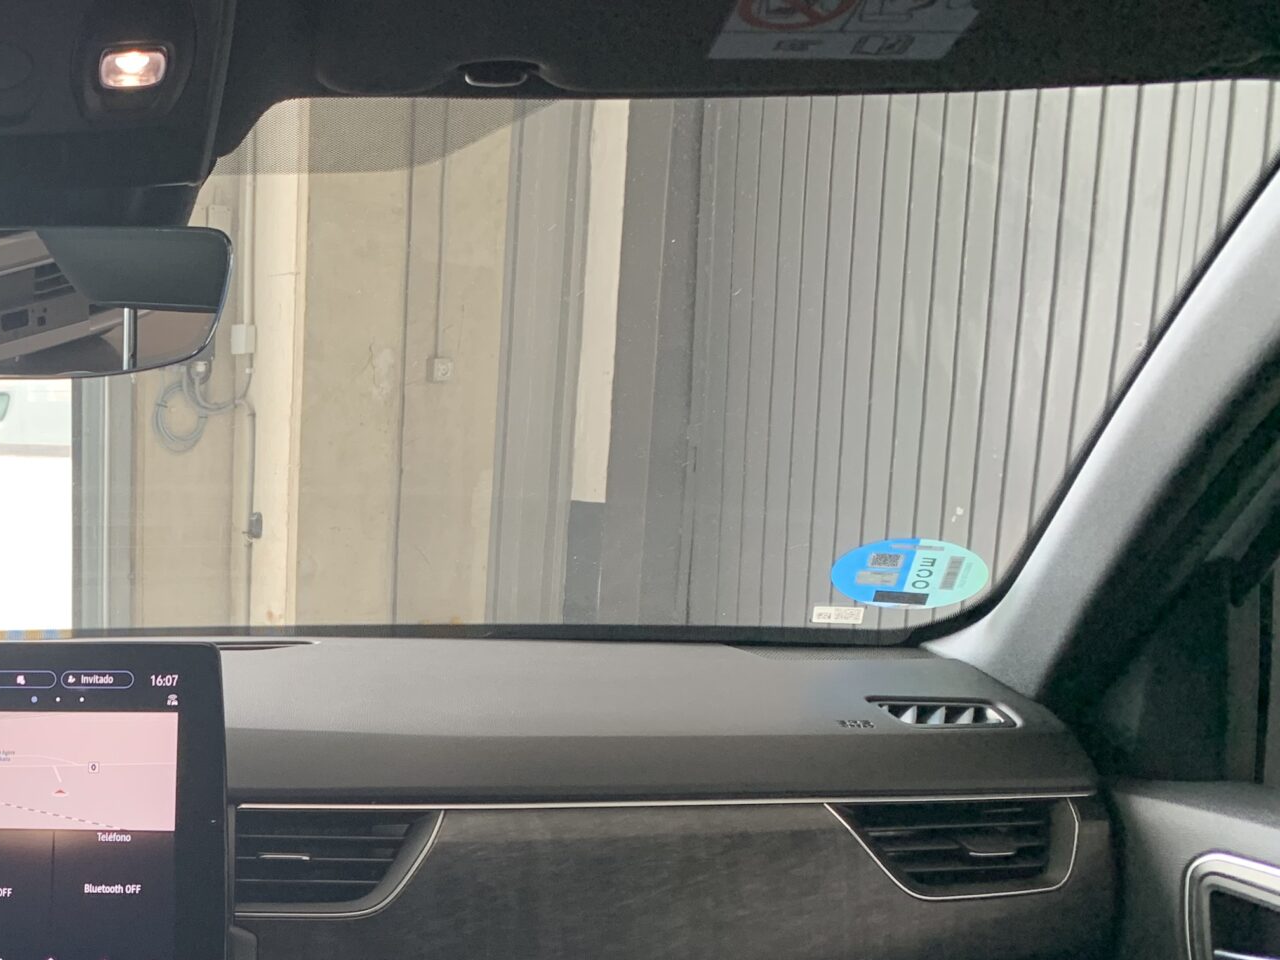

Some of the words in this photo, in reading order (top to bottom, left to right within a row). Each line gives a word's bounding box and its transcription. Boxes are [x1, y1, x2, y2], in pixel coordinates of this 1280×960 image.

[912, 557, 936, 589] ECO
[81, 674, 114, 685] Invitado
[150, 674, 179, 687] 16:07
[97, 832, 131, 843] Teléfono
[84, 884, 124, 895] Bluetooth
[125, 884, 141, 895] OFF
